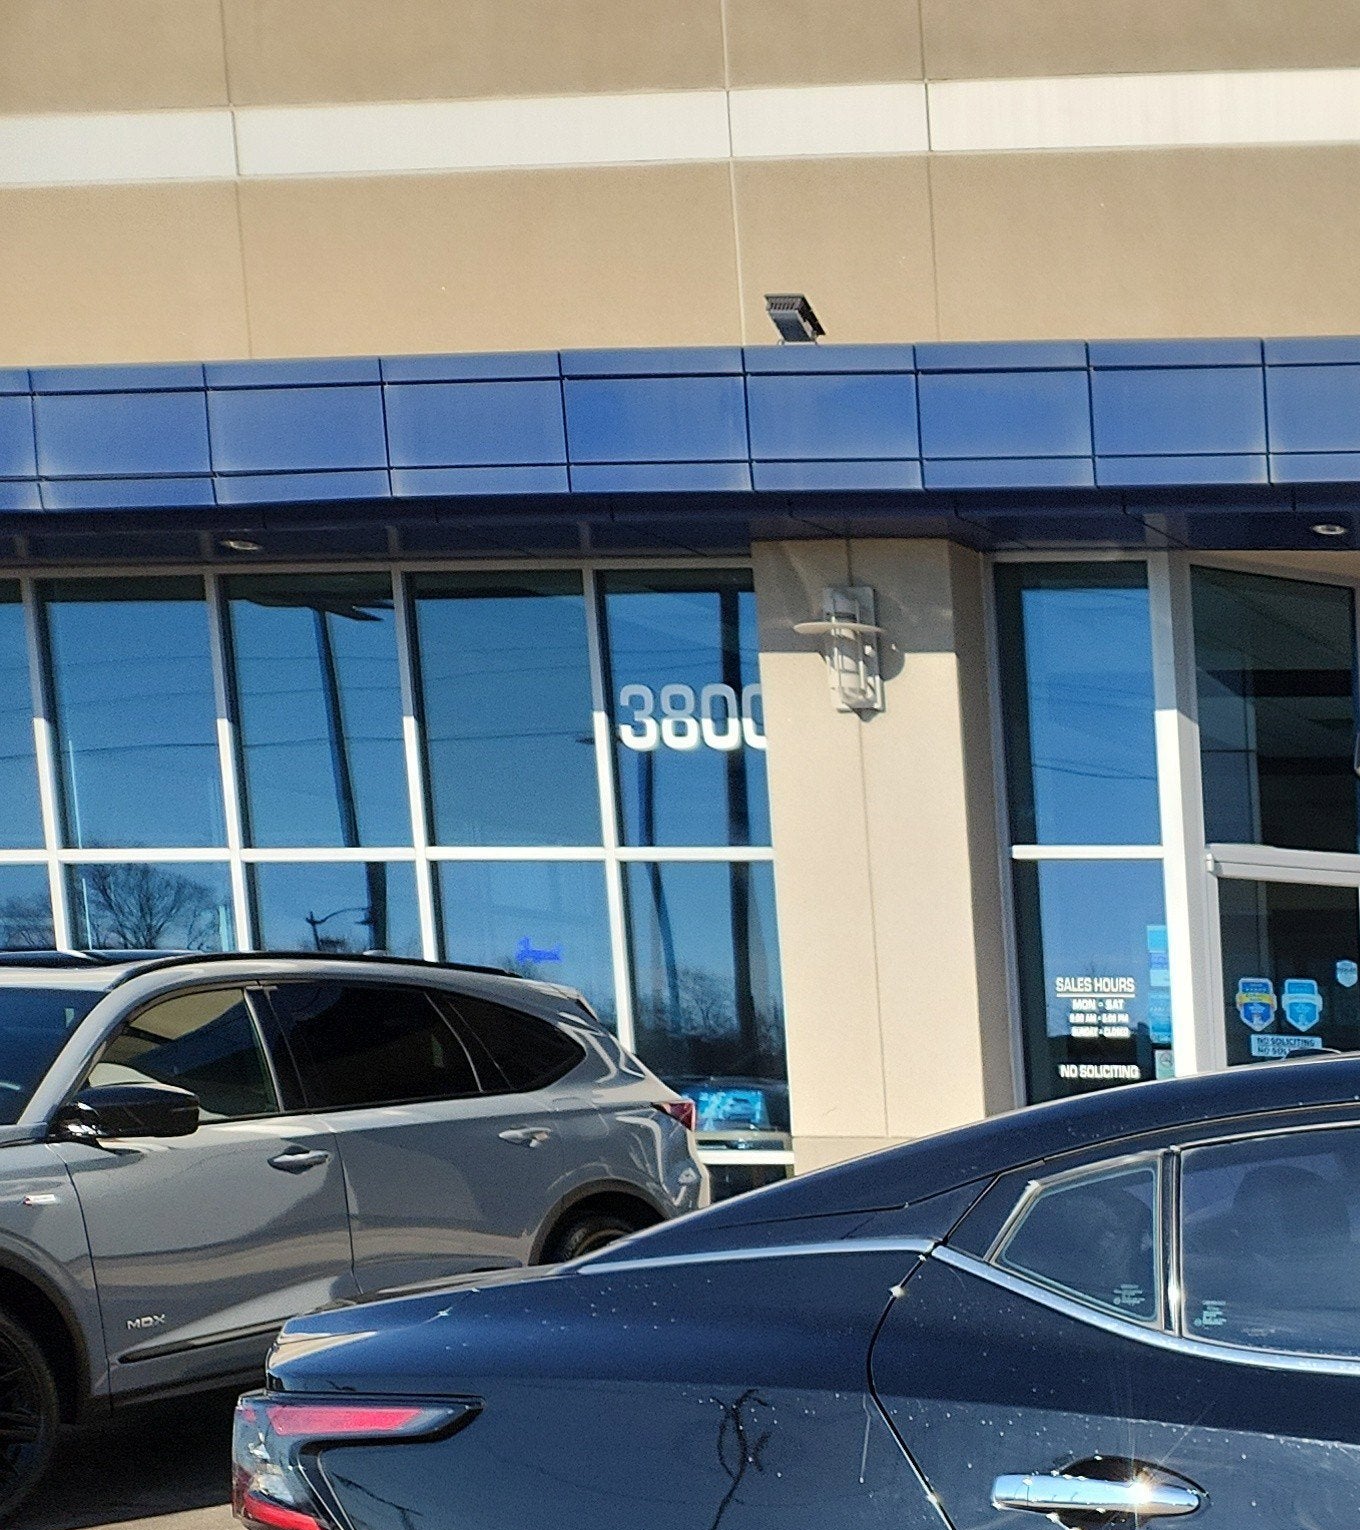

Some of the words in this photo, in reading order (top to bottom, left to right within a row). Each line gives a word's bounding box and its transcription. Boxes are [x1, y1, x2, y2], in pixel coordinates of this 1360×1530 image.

[1055, 976, 1093, 993] SALES
[1094, 976, 1135, 993] HOURS
[1072, 998, 1097, 1011] MON
[1105, 998, 1125, 1012] SAT
[1060, 1064, 1078, 1078] NO
[1079, 1064, 1141, 1079] SOLICITING
[126, 1313, 166, 1330] MDX
